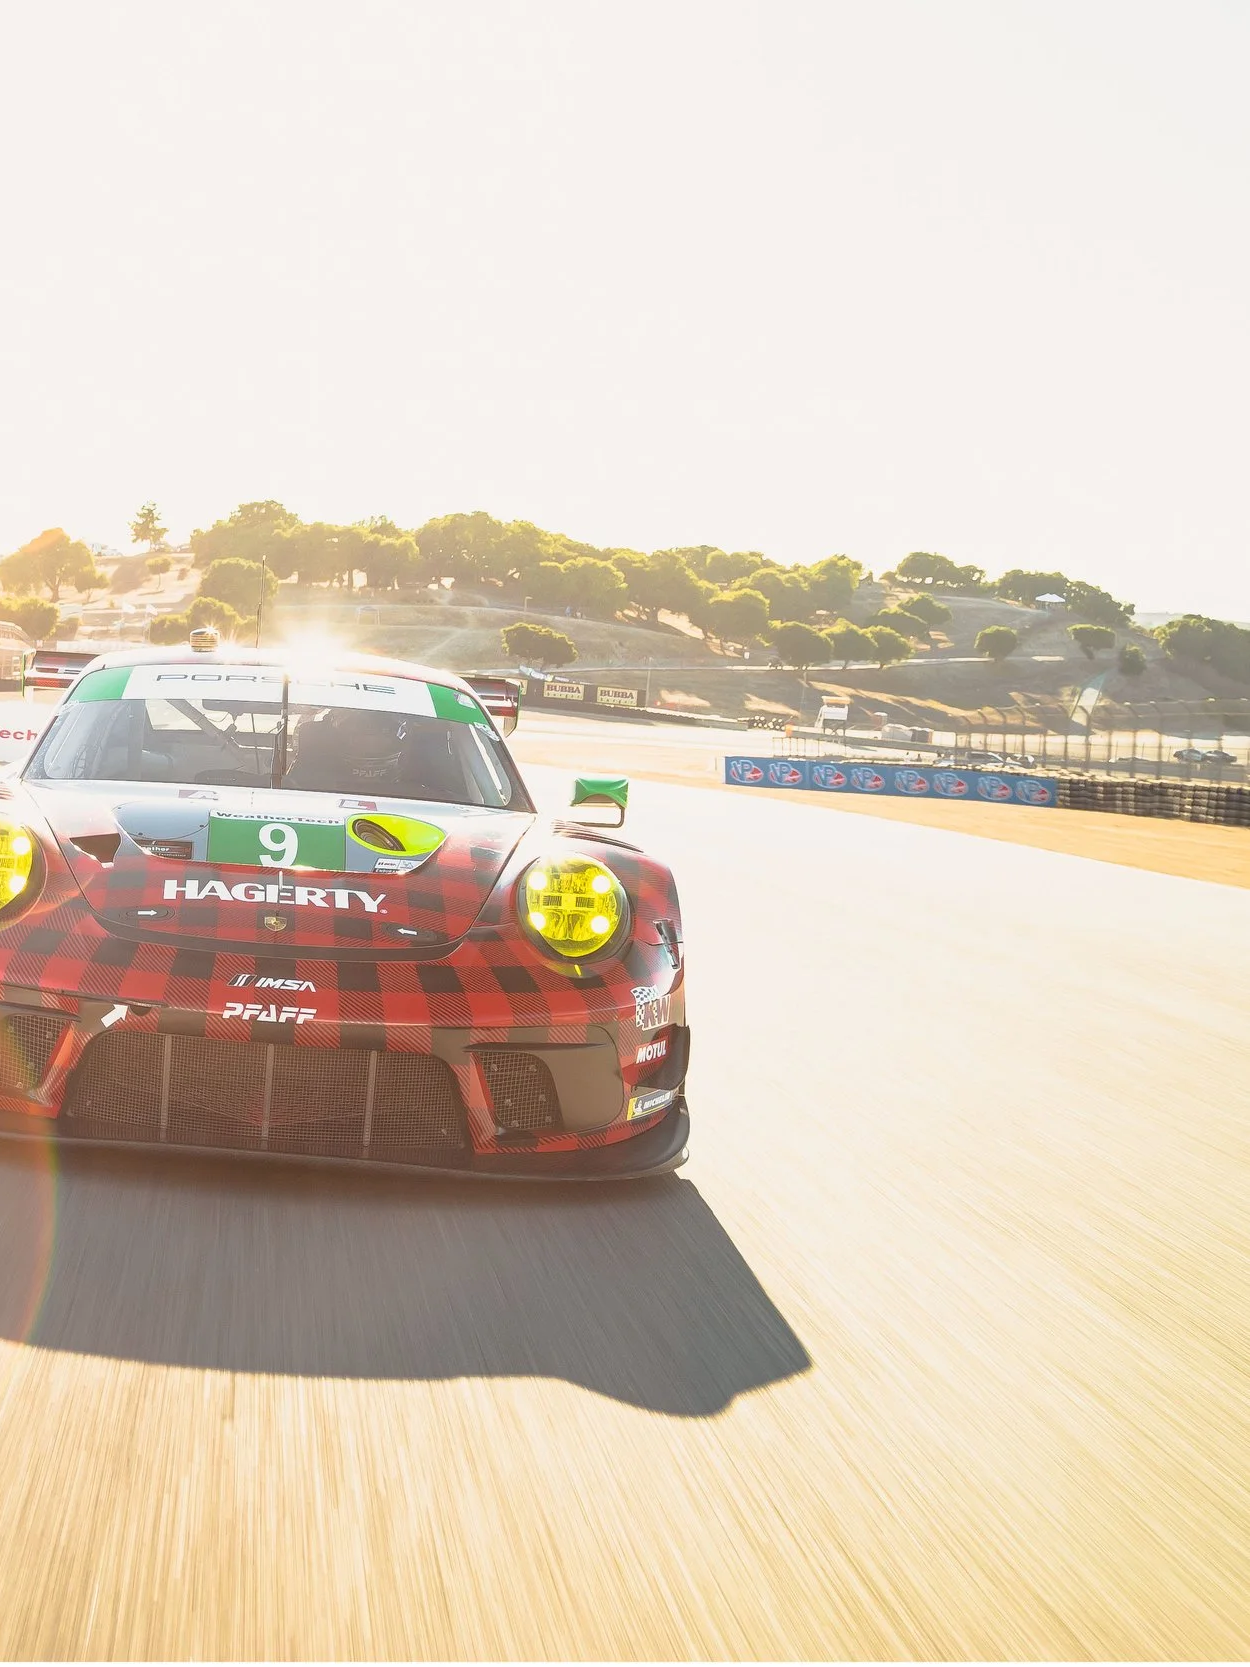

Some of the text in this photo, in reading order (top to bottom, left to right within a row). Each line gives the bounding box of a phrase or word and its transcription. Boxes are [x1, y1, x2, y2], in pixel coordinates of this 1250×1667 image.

[156, 674, 396, 695] PORSHE
[546, 684, 581, 694] BUBBA
[600, 689, 635, 700] BUBBA
[258, 822, 298, 868] 9
[163, 879, 387, 913] HAGERTY
[255, 976, 317, 992] IMSA
[222, 1002, 317, 1024] PFAFF
[639, 995, 671, 1031] KW
[636, 1040, 667, 1064] MOTUL
